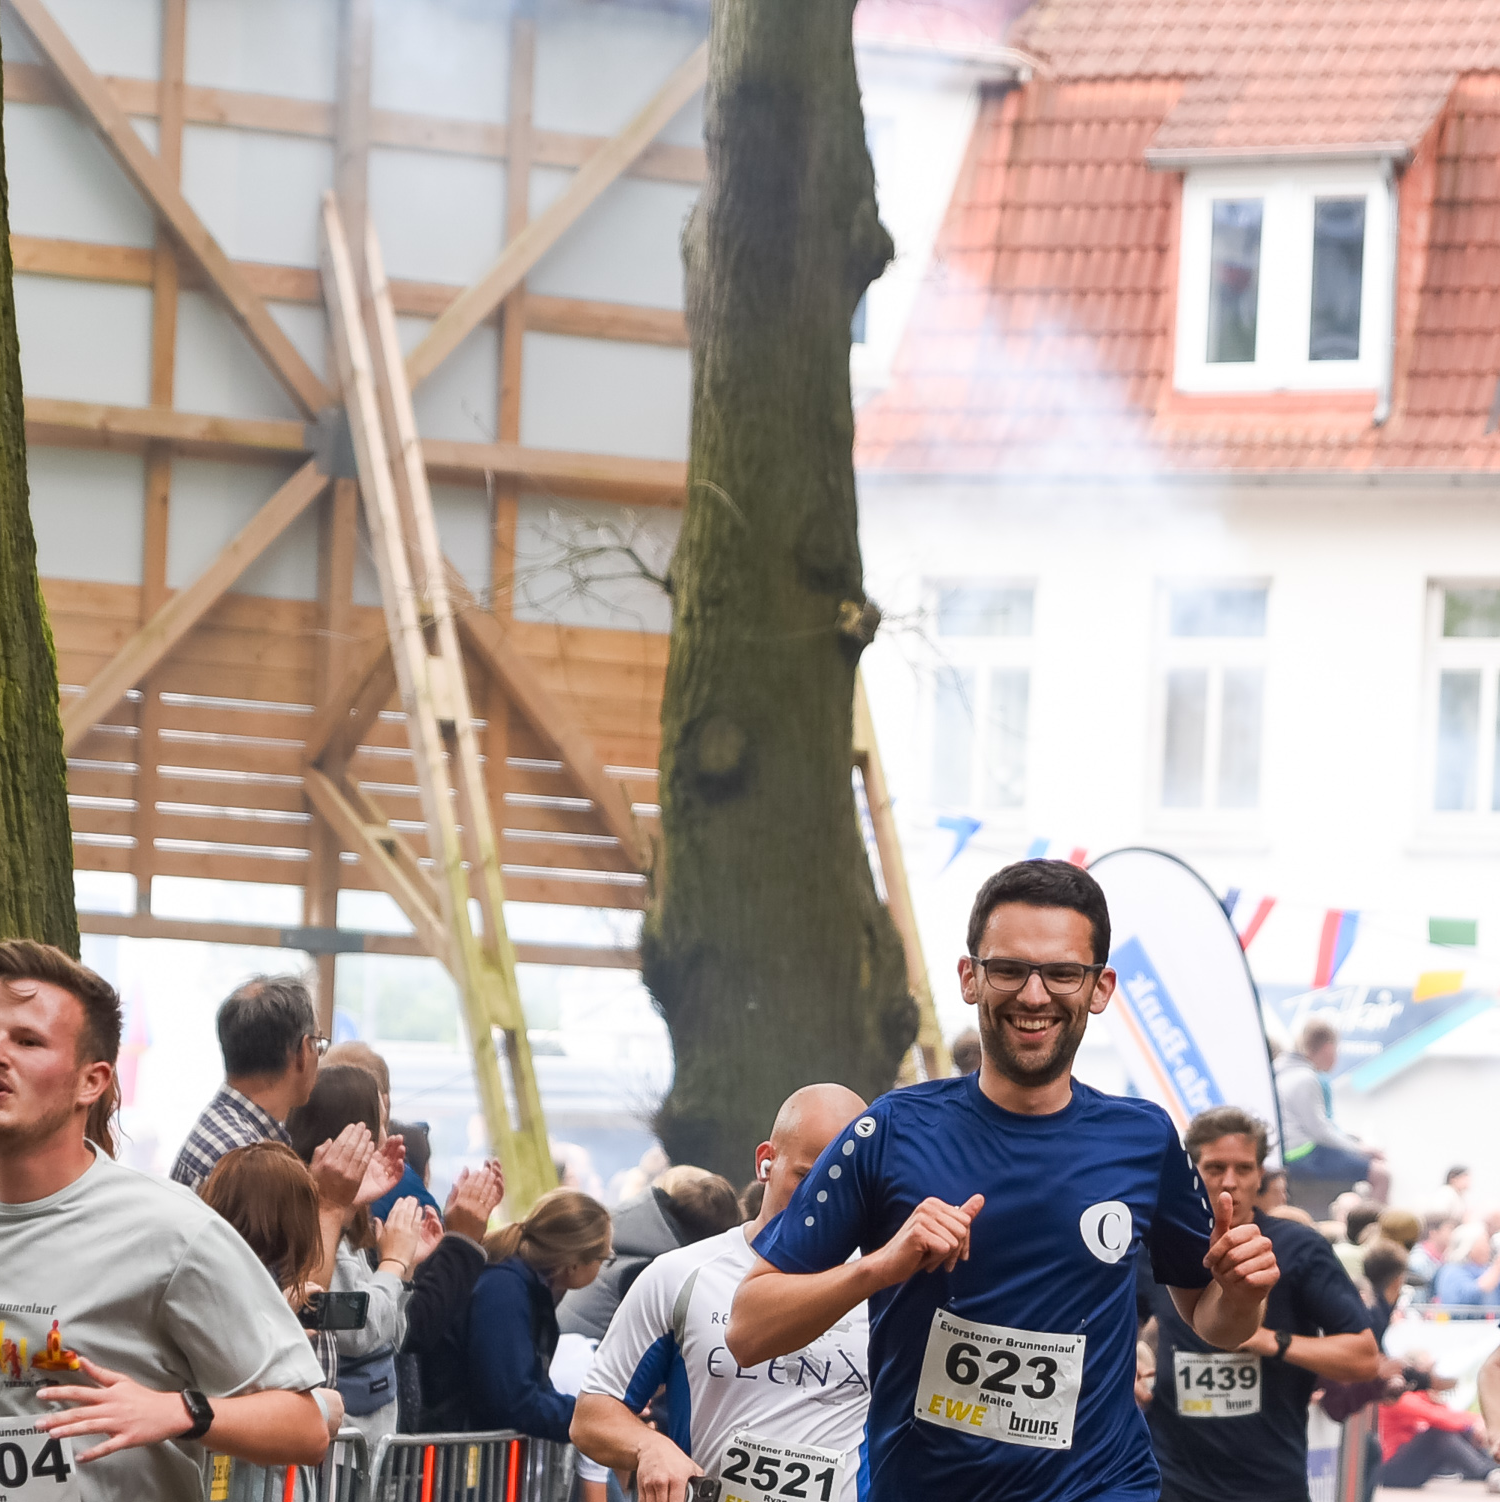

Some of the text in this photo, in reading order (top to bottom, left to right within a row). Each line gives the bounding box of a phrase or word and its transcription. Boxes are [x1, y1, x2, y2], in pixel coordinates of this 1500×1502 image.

[1098, 1212, 1121, 1250] C
[711, 1311, 728, 1325] RE
[939, 1321, 1076, 1354] Everstener Brunnenlauf
[945, 1342, 1058, 1400] 623
[1179, 1366, 1257, 1390] 1439
[928, 1394, 987, 1427] EWE
[978, 1393, 1013, 1408] Malte
[1009, 1411, 1059, 1436] bruns
[734, 1436, 838, 1465] Everstener Brunnenlauf
[721, 1447, 835, 1502] 2521
